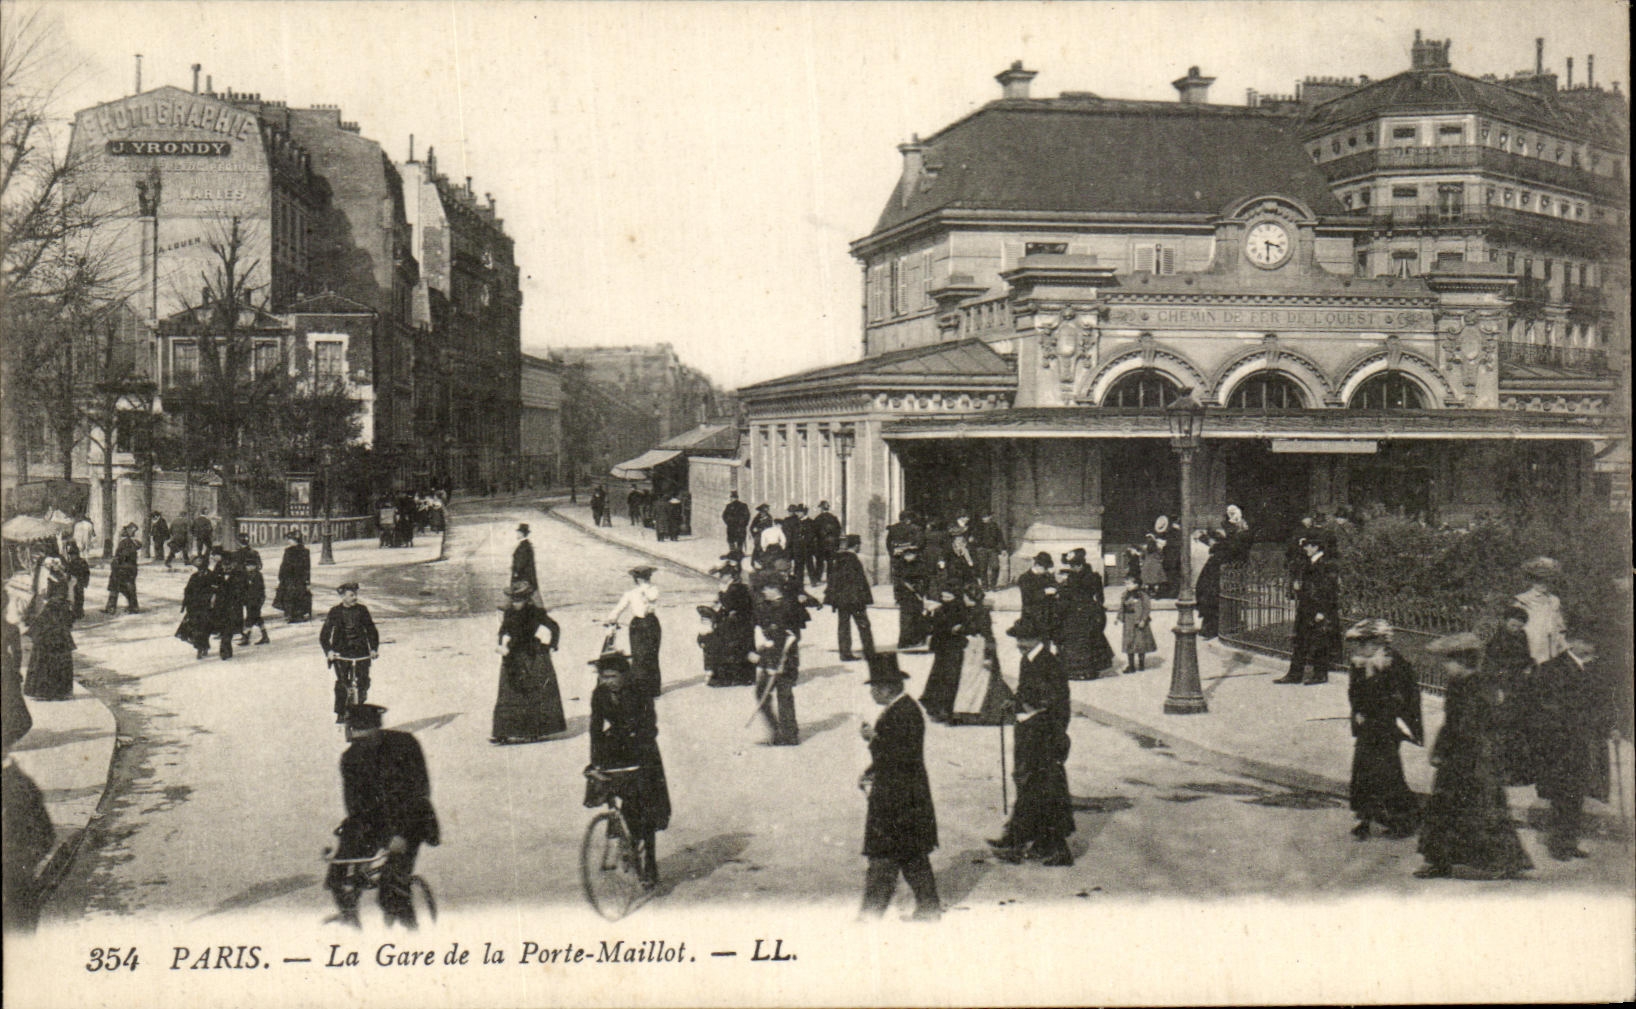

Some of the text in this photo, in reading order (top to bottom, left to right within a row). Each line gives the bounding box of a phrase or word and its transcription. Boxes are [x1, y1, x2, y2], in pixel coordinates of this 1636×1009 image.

[82, 100, 257, 142] PHOTOGRAPHIE
[132, 142, 225, 154] YRONDY
[1157, 311, 1217, 327] CHEMIN
[1223, 312, 1243, 327] DE
[1250, 312, 1280, 328] FER
[1287, 313, 1306, 328] DE
